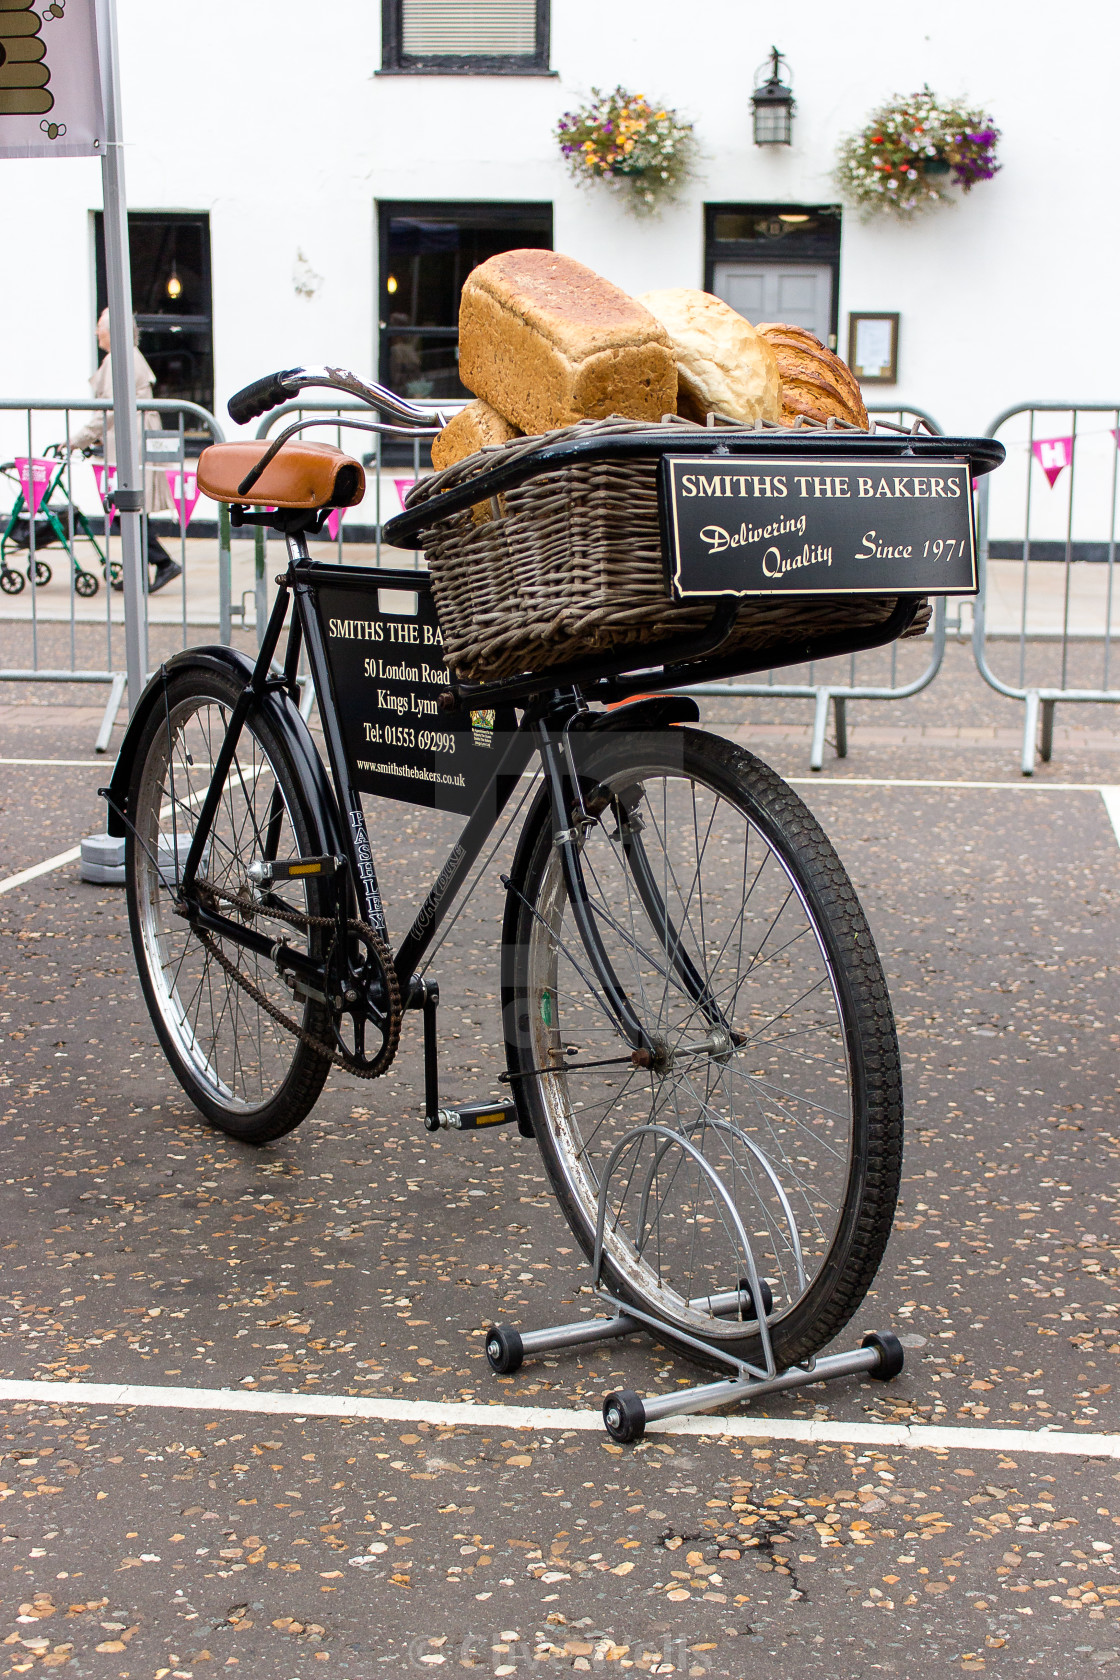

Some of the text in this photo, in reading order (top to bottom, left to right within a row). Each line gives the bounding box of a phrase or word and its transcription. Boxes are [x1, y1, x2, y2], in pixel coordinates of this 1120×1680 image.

[1040, 441, 1067, 468] H
[682, 475, 961, 498] SMITHS THE BAKERS
[700, 514, 806, 554] Delivering
[854, 530, 966, 562] Since 1971
[762, 543, 833, 578] Quality
[329, 618, 447, 646] SMITHS THE BA
[364, 658, 451, 685] 50 London Road
[377, 689, 439, 718] Kings Lynn
[363, 722, 383, 744] Tel:
[384, 725, 415, 748] 01553
[418, 730, 456, 754] 692993
[356, 759, 466, 787] www.smithsthebakers.co.uk
[350, 811, 385, 929] PASHLEY
